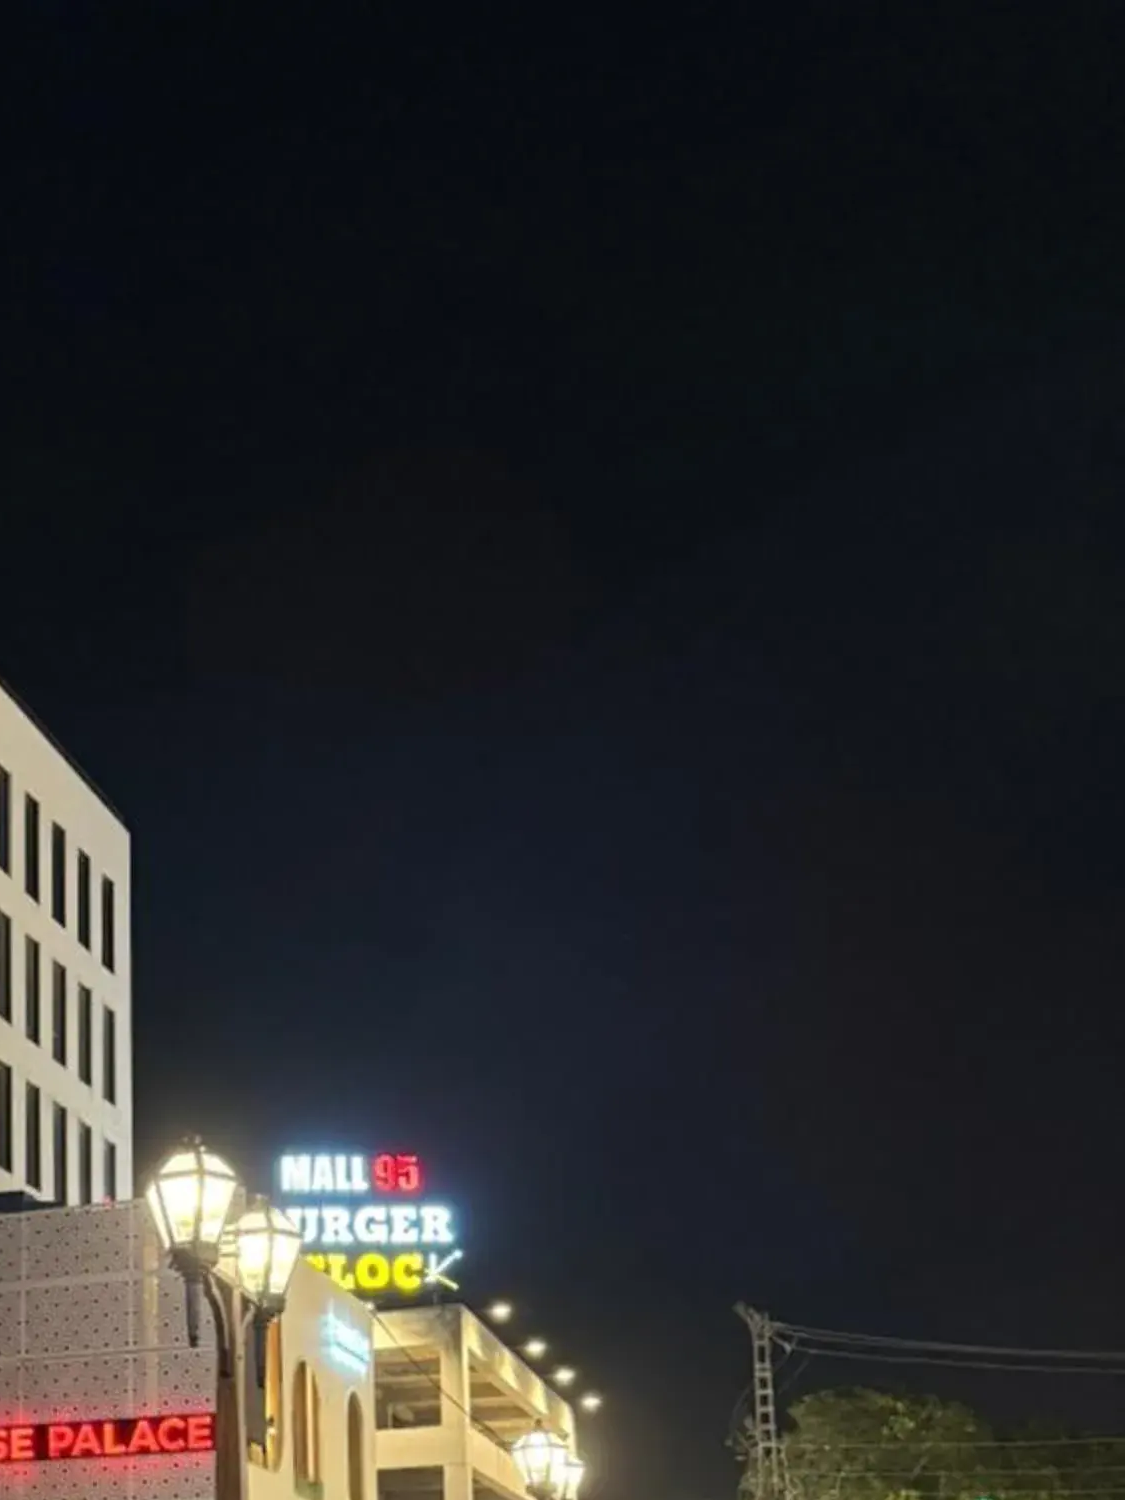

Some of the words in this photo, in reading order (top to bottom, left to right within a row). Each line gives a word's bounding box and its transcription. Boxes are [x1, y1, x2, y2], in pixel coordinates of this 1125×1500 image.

[280, 1155, 369, 1192] MALL
[375, 1154, 421, 1192] 95
[286, 1205, 455, 1244] URGER
[303, 1249, 463, 1291] LOCK
[47, 1414, 213, 1458] PALACE
